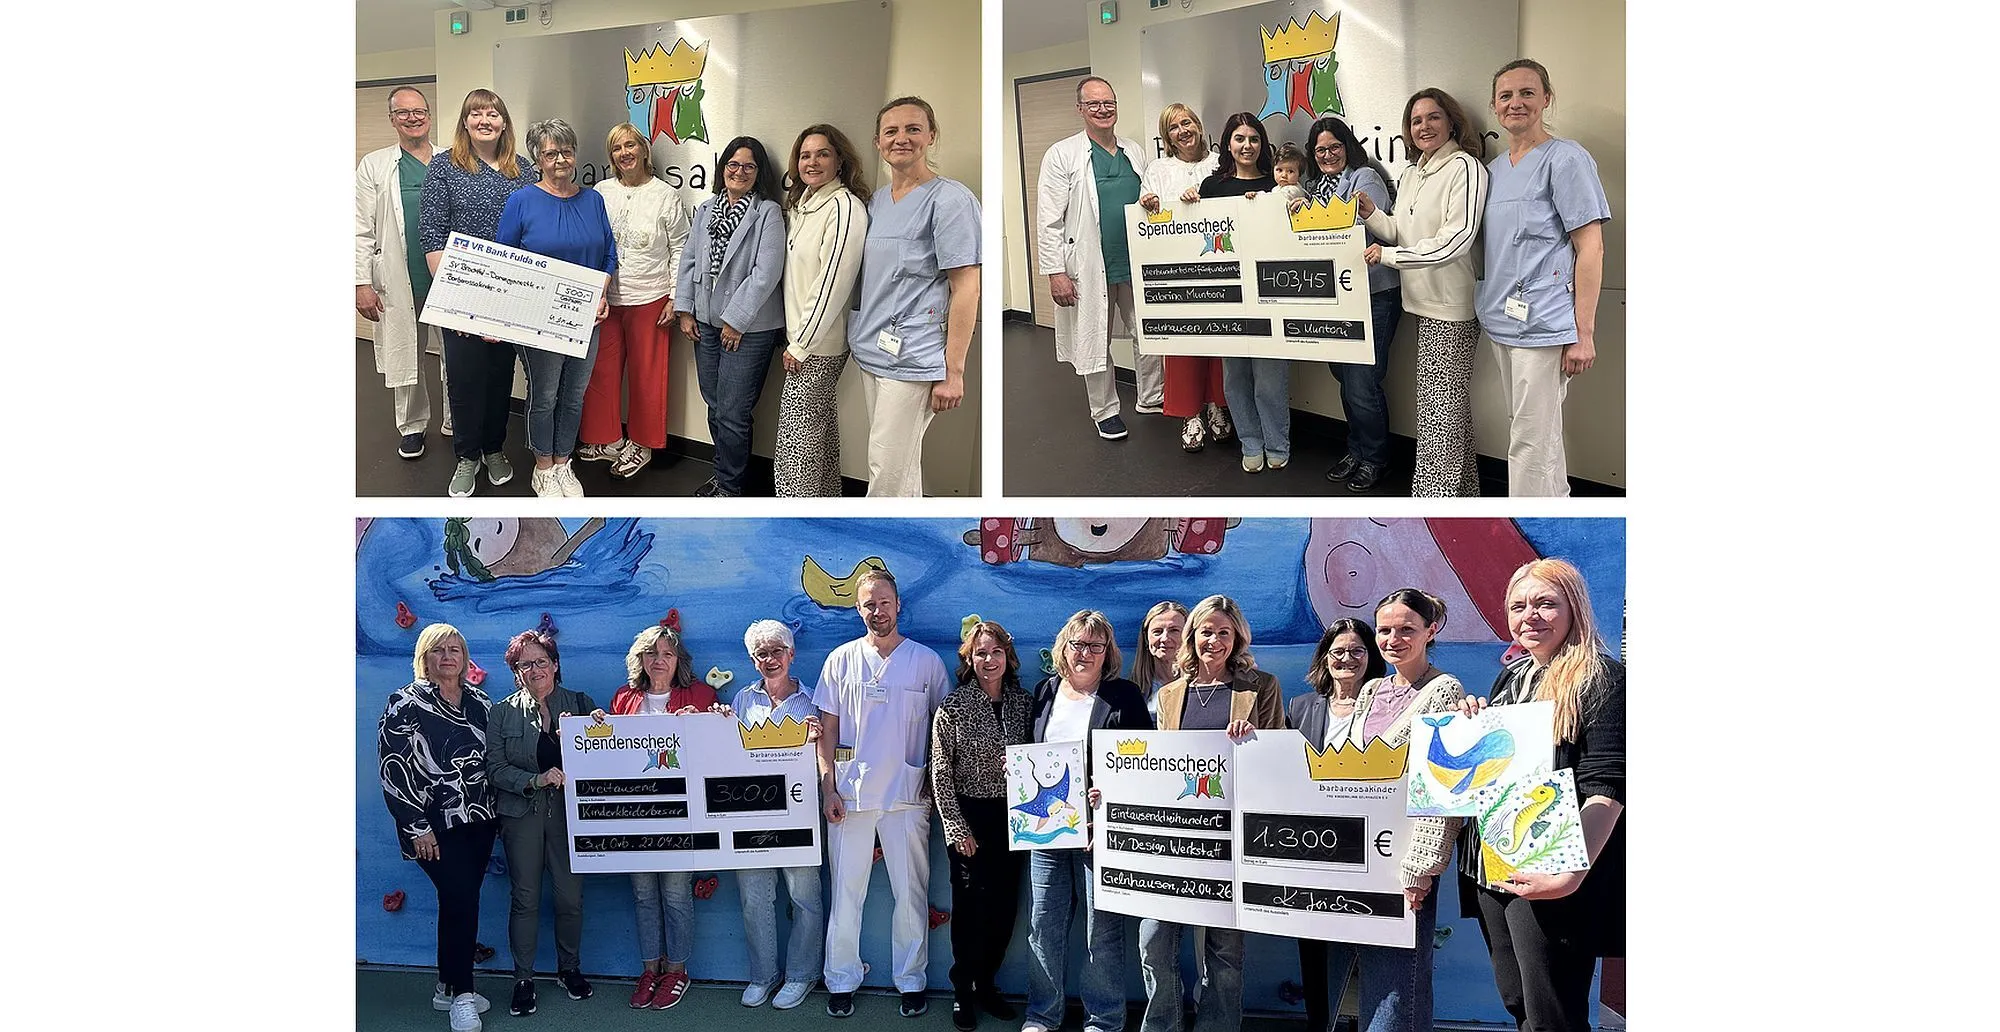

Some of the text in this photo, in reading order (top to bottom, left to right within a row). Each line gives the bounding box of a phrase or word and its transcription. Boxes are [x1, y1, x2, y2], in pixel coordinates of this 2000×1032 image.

[1138, 217, 1235, 239] Spendenscheck
[1298, 233, 1352, 241] Barbarossakinder
[472, 242, 548, 269] VR Bank Fulda eG
[1262, 267, 1327, 292] 403,45
[1339, 269, 1353, 291] €
[574, 733, 681, 754] Spendenscheck
[1106, 751, 1227, 773] Spendenscheck
[790, 783, 803, 803] €
[1319, 784, 1397, 794] Barbarossakinder
[1108, 832, 1125, 851] My
[1128, 837, 1166, 855] Design
[1253, 826, 1337, 848] 1.300
[1373, 830, 1394, 857] €
